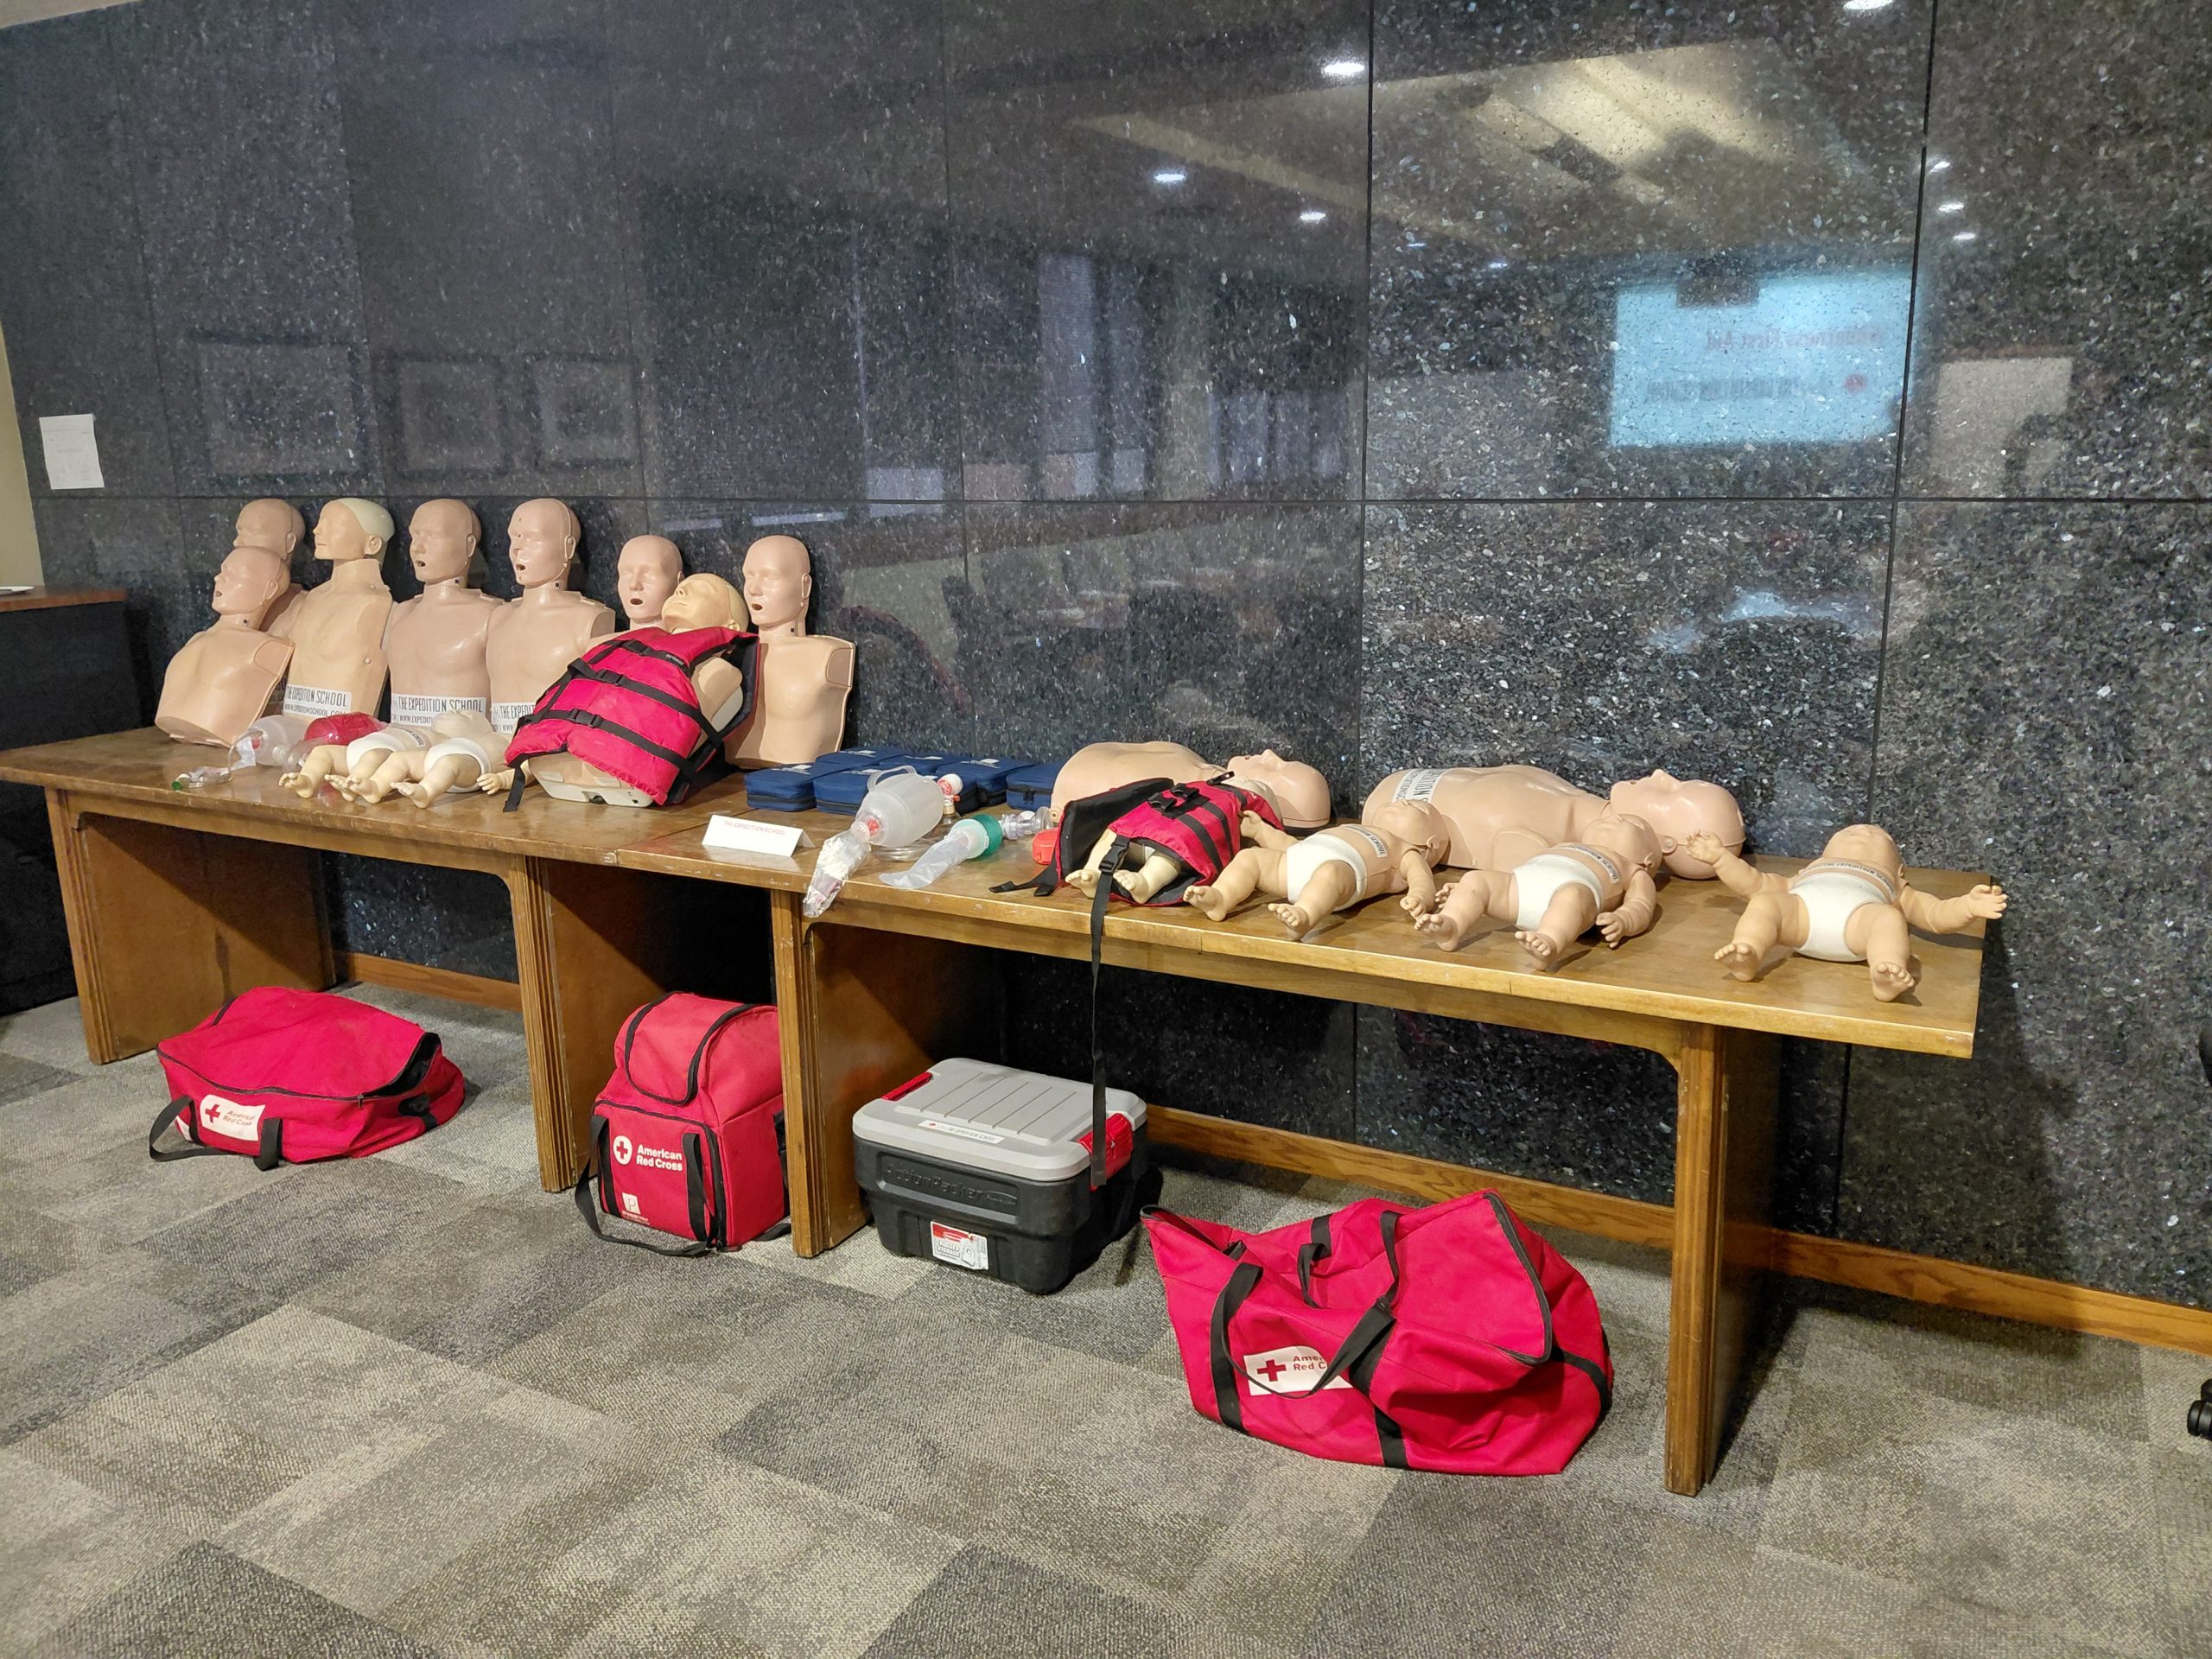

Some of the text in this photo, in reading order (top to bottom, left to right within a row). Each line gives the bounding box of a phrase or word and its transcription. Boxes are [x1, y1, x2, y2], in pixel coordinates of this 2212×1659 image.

[315, 690, 347, 708] SCHOOL
[398, 696, 483, 713] THE EXPEDITION SCHOOL
[499, 704, 510, 720] THE
[733, 821, 764, 832] EXPEDITION
[764, 827, 786, 836] SCHOOL
[637, 1143, 683, 1161] American
[636, 1154, 683, 1173] Red Cross
[885, 1163, 983, 1200] ActionPacker
[1293, 1363, 1315, 1372] Red
